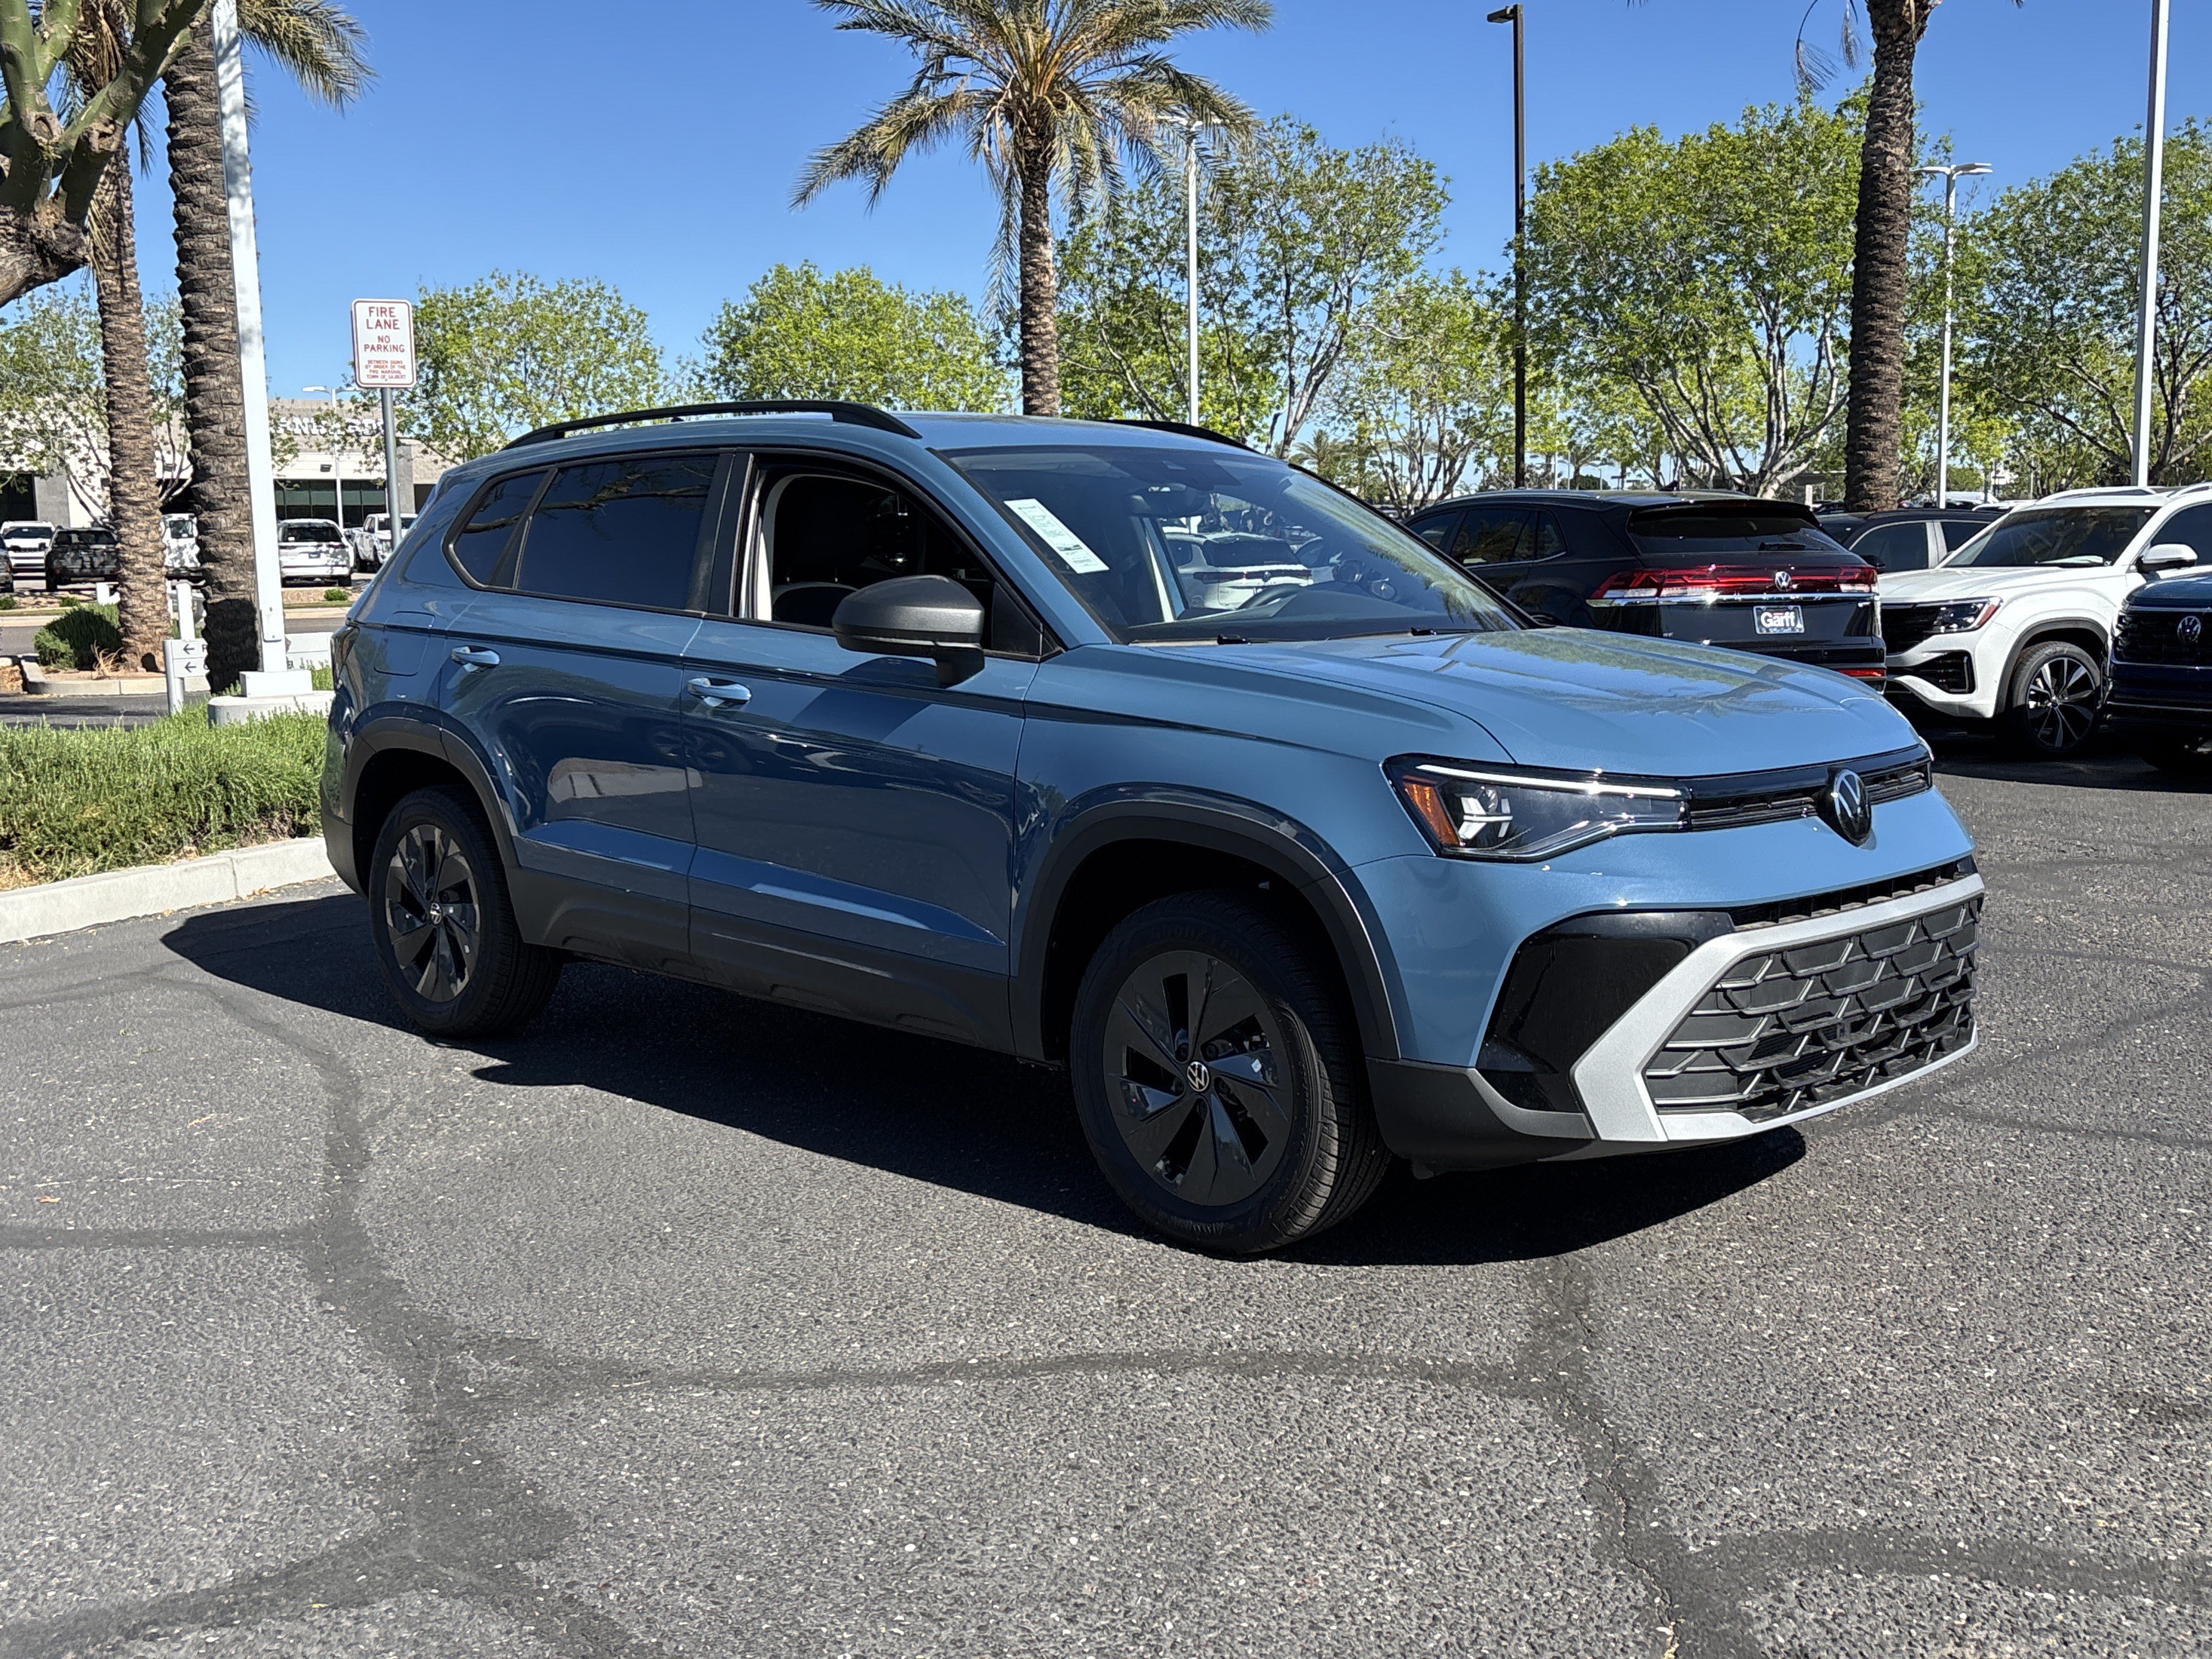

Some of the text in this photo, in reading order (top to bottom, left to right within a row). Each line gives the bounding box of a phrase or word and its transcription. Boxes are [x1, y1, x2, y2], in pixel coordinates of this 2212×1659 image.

[369, 306, 396, 317] FIRE
[366, 319, 400, 330] LANE
[377, 335, 391, 343] NO
[364, 344, 405, 353] PARKING
[1760, 612, 1795, 628] Garff
